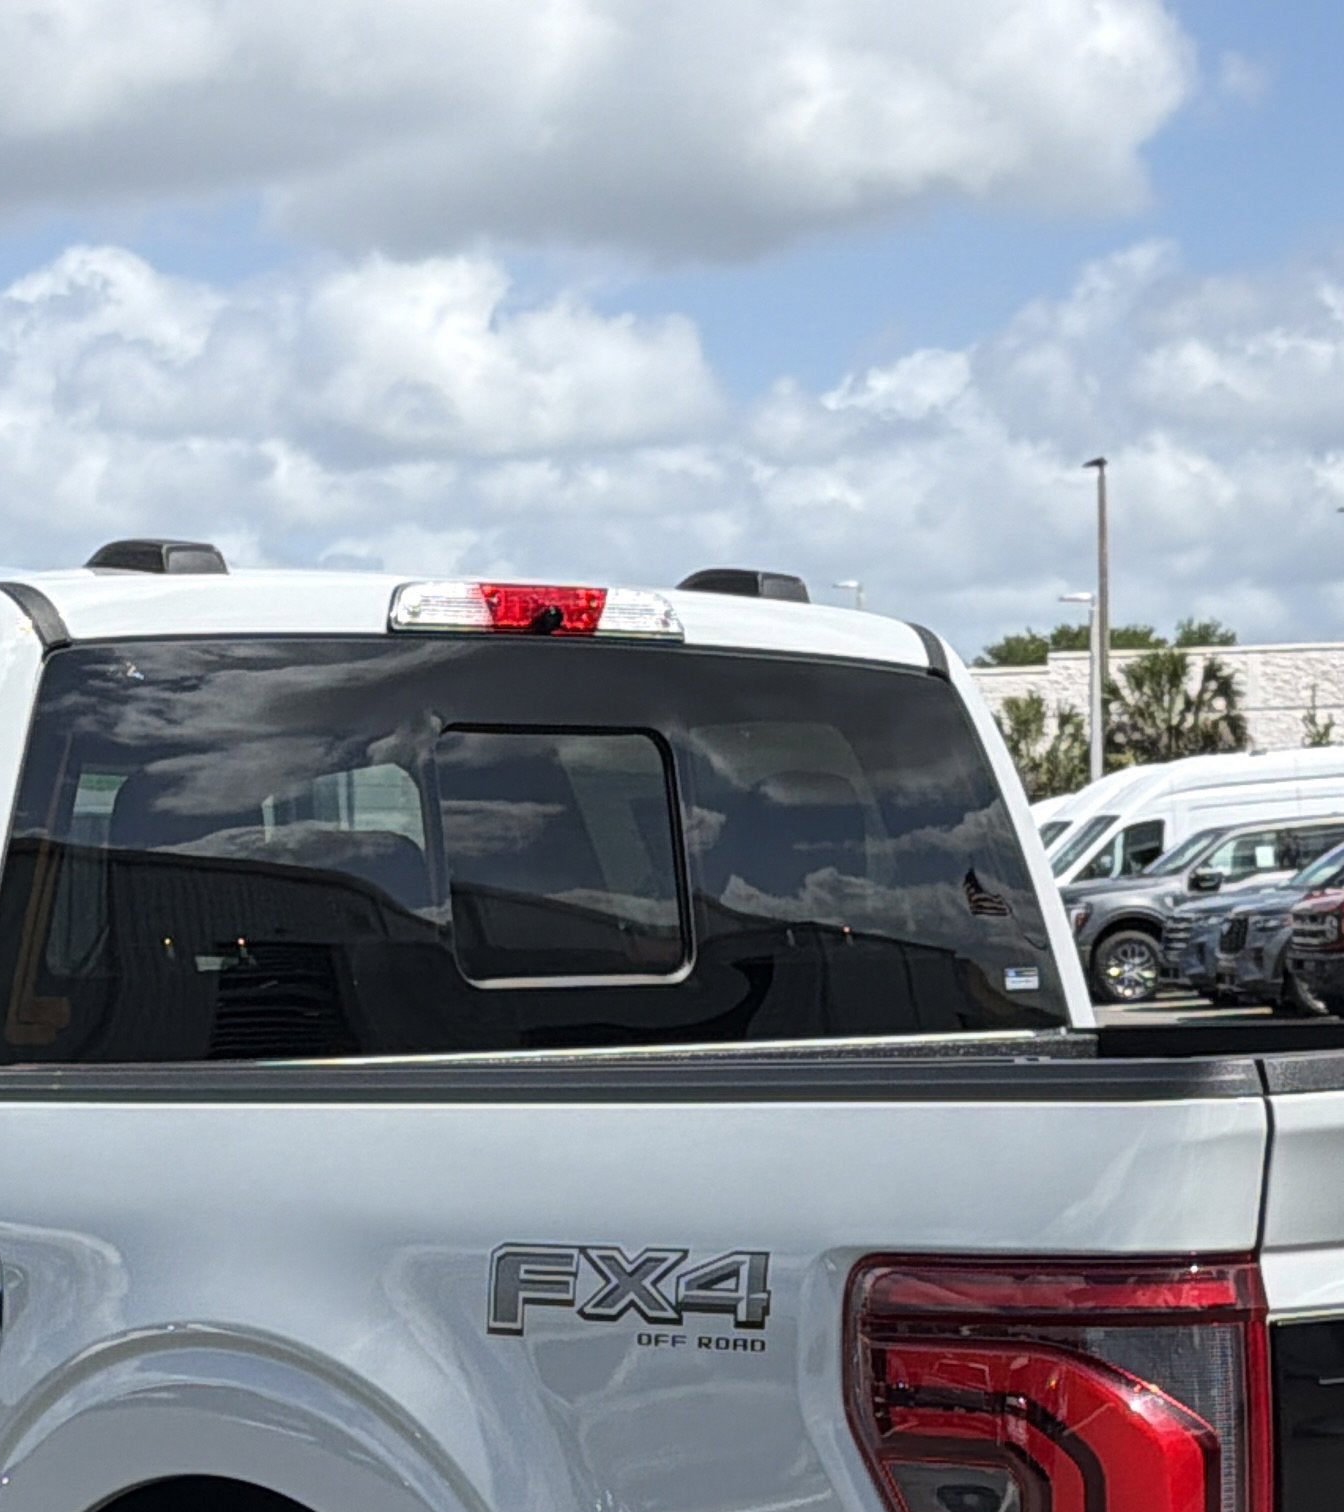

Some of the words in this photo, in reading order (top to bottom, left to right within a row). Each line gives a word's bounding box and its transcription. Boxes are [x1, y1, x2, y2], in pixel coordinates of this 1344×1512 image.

[487, 1242, 771, 1336] FX4
[636, 1332, 688, 1349] OFF
[697, 1335, 766, 1353] ROAD
